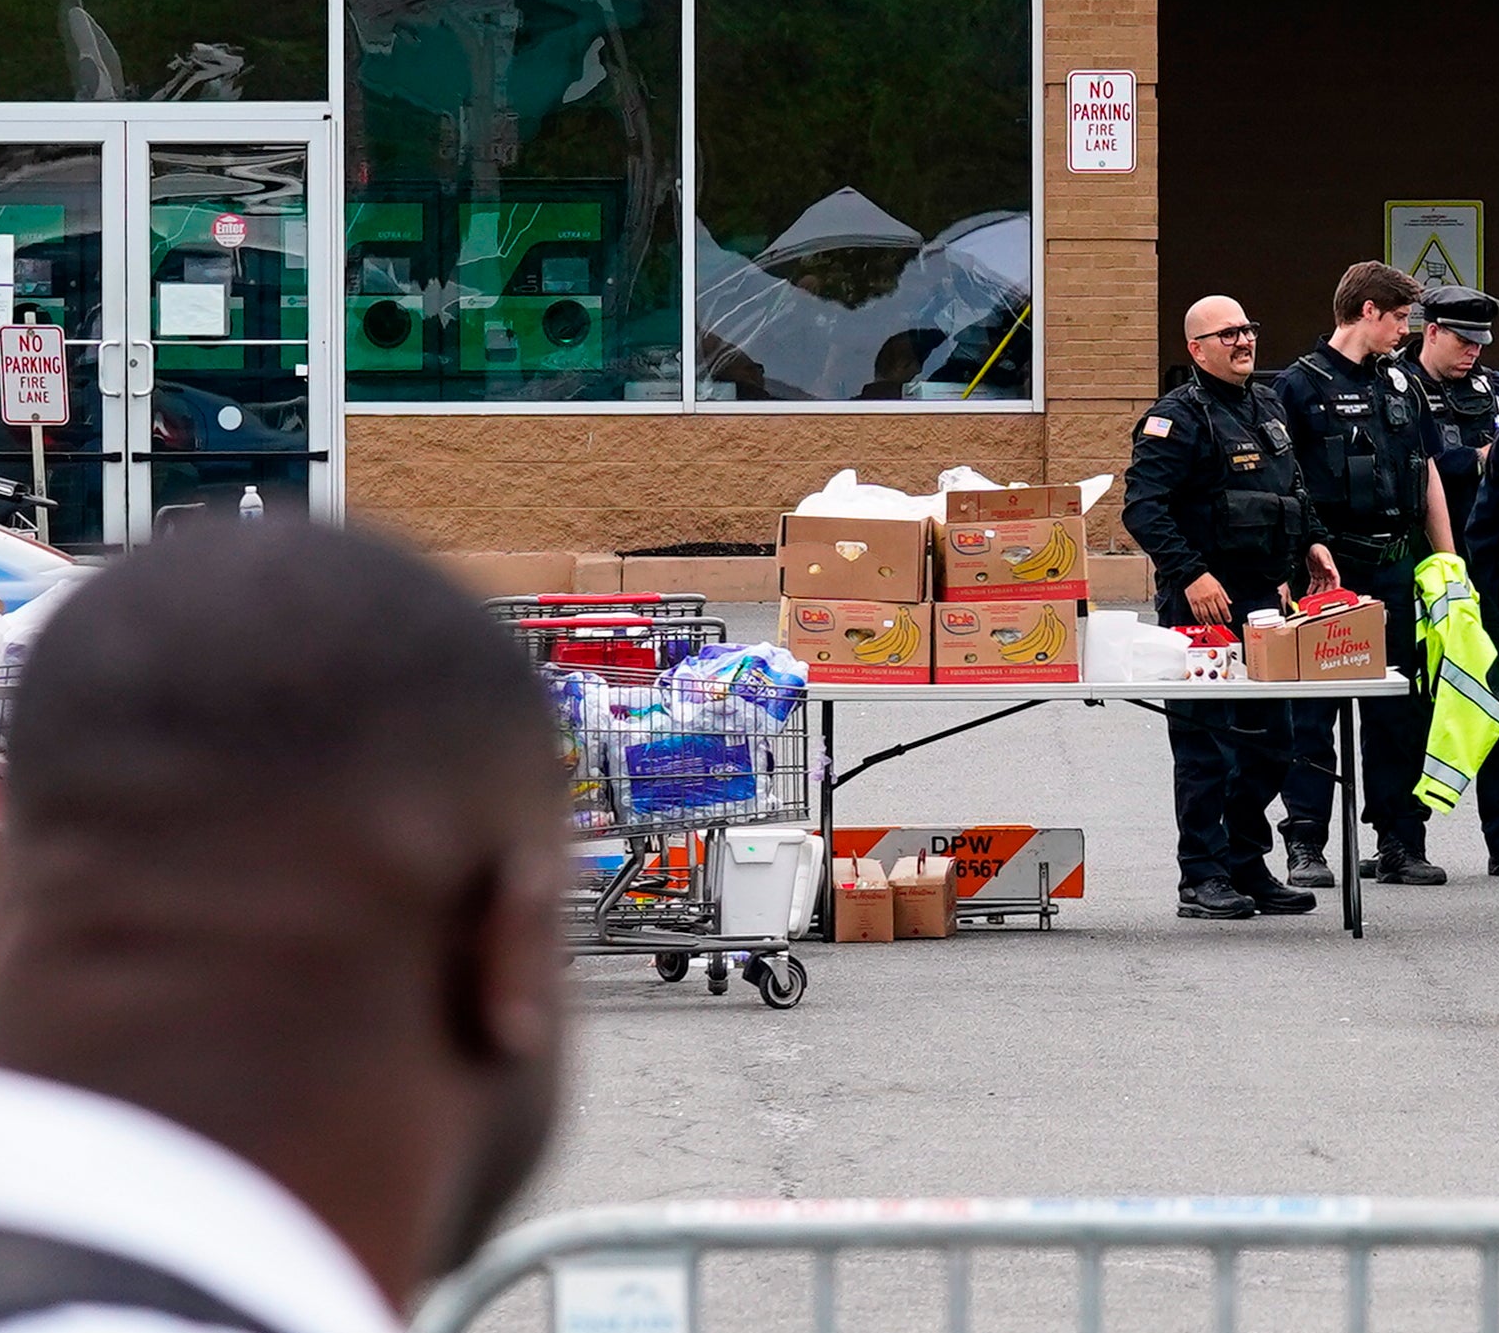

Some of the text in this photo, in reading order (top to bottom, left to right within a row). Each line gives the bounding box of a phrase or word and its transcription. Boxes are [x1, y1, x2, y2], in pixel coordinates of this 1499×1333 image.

[1090, 80, 1114, 99] NO
[1073, 103, 1131, 121] PARKING
[1088, 123, 1115, 136] FIRE
[1085, 138, 1118, 151] LANE
[216, 221, 245, 234] Enter
[19, 334, 43, 353] NO
[5, 356, 61, 375] PARKING
[20, 376, 46, 389] FIRE
[18, 391, 50, 404] LANE
[957, 532, 985, 545] Dole
[802, 609, 830, 622] Dole
[947, 612, 975, 624] Dole
[1323, 619, 1352, 641] Tim
[1314, 638, 1371, 661] Hortons
[1320, 658, 1343, 670] share
[1350, 653, 1371, 667] enjoy
[931, 836, 993, 854] DPW
